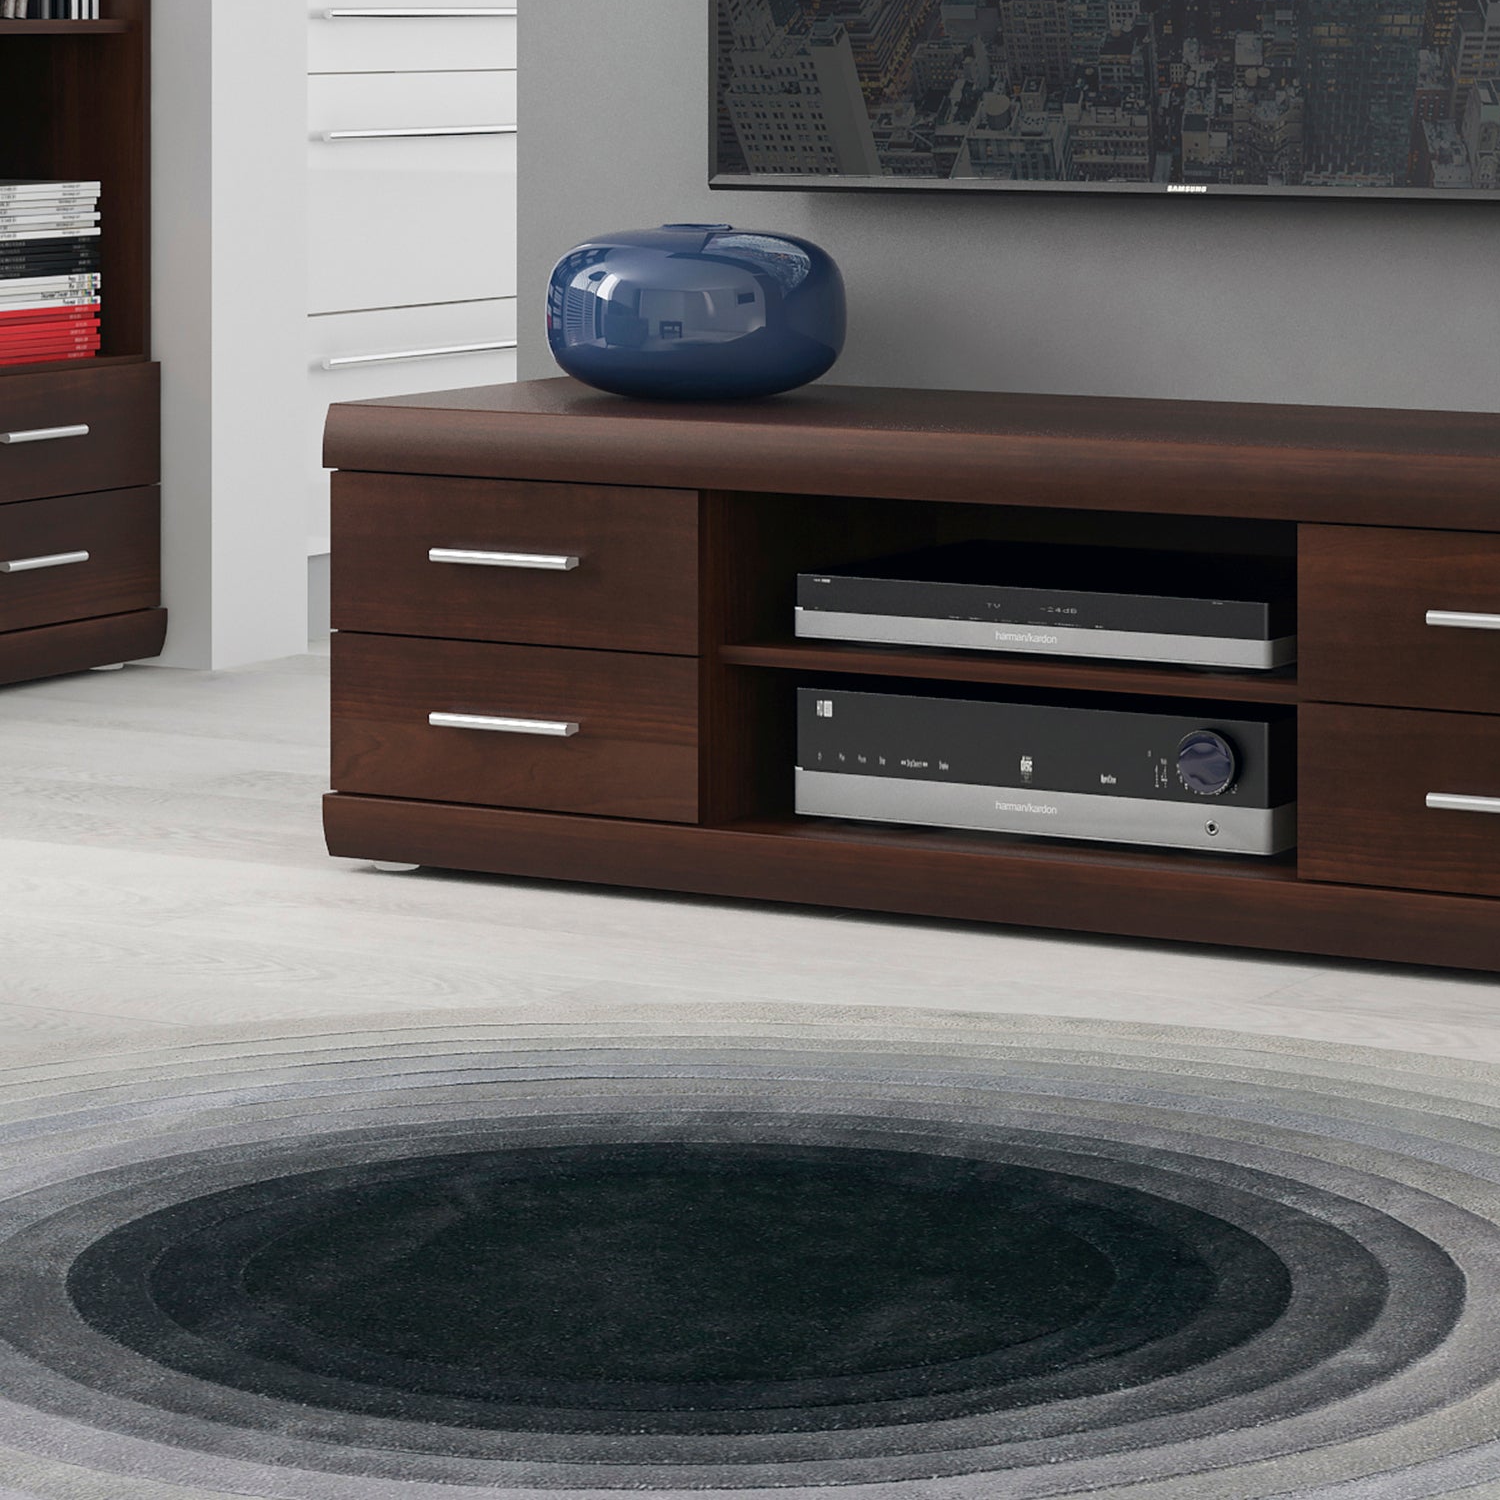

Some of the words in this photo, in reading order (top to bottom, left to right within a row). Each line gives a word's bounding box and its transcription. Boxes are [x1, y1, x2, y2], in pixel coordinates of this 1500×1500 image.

[1167, 185, 1207, 193] SAMSUNG
[995, 630, 1058, 645] harman/kardon
[995, 800, 1058, 815] harman/kardon
